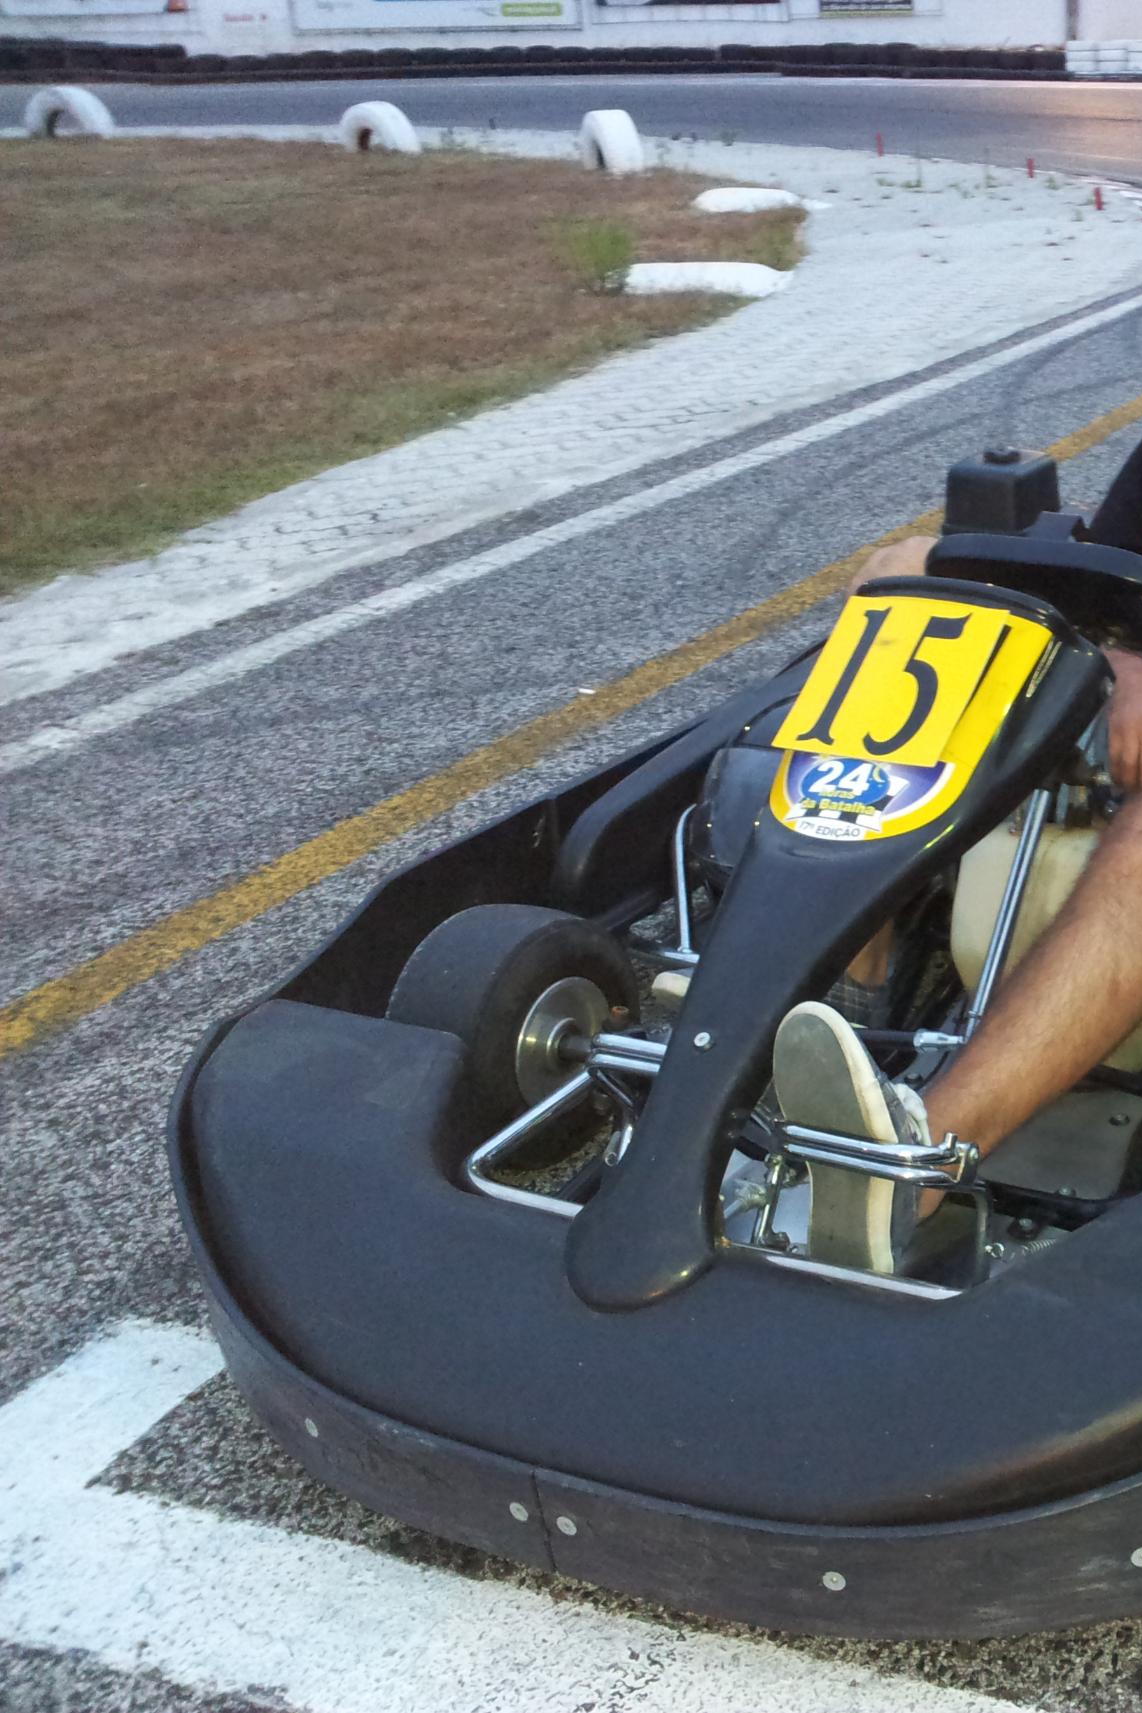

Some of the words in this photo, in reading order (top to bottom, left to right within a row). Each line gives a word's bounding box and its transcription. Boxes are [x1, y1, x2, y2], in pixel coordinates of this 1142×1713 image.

[796, 606, 973, 755] 15
[808, 760, 874, 796] 24
[816, 825, 860, 837] EDIÇÃO
